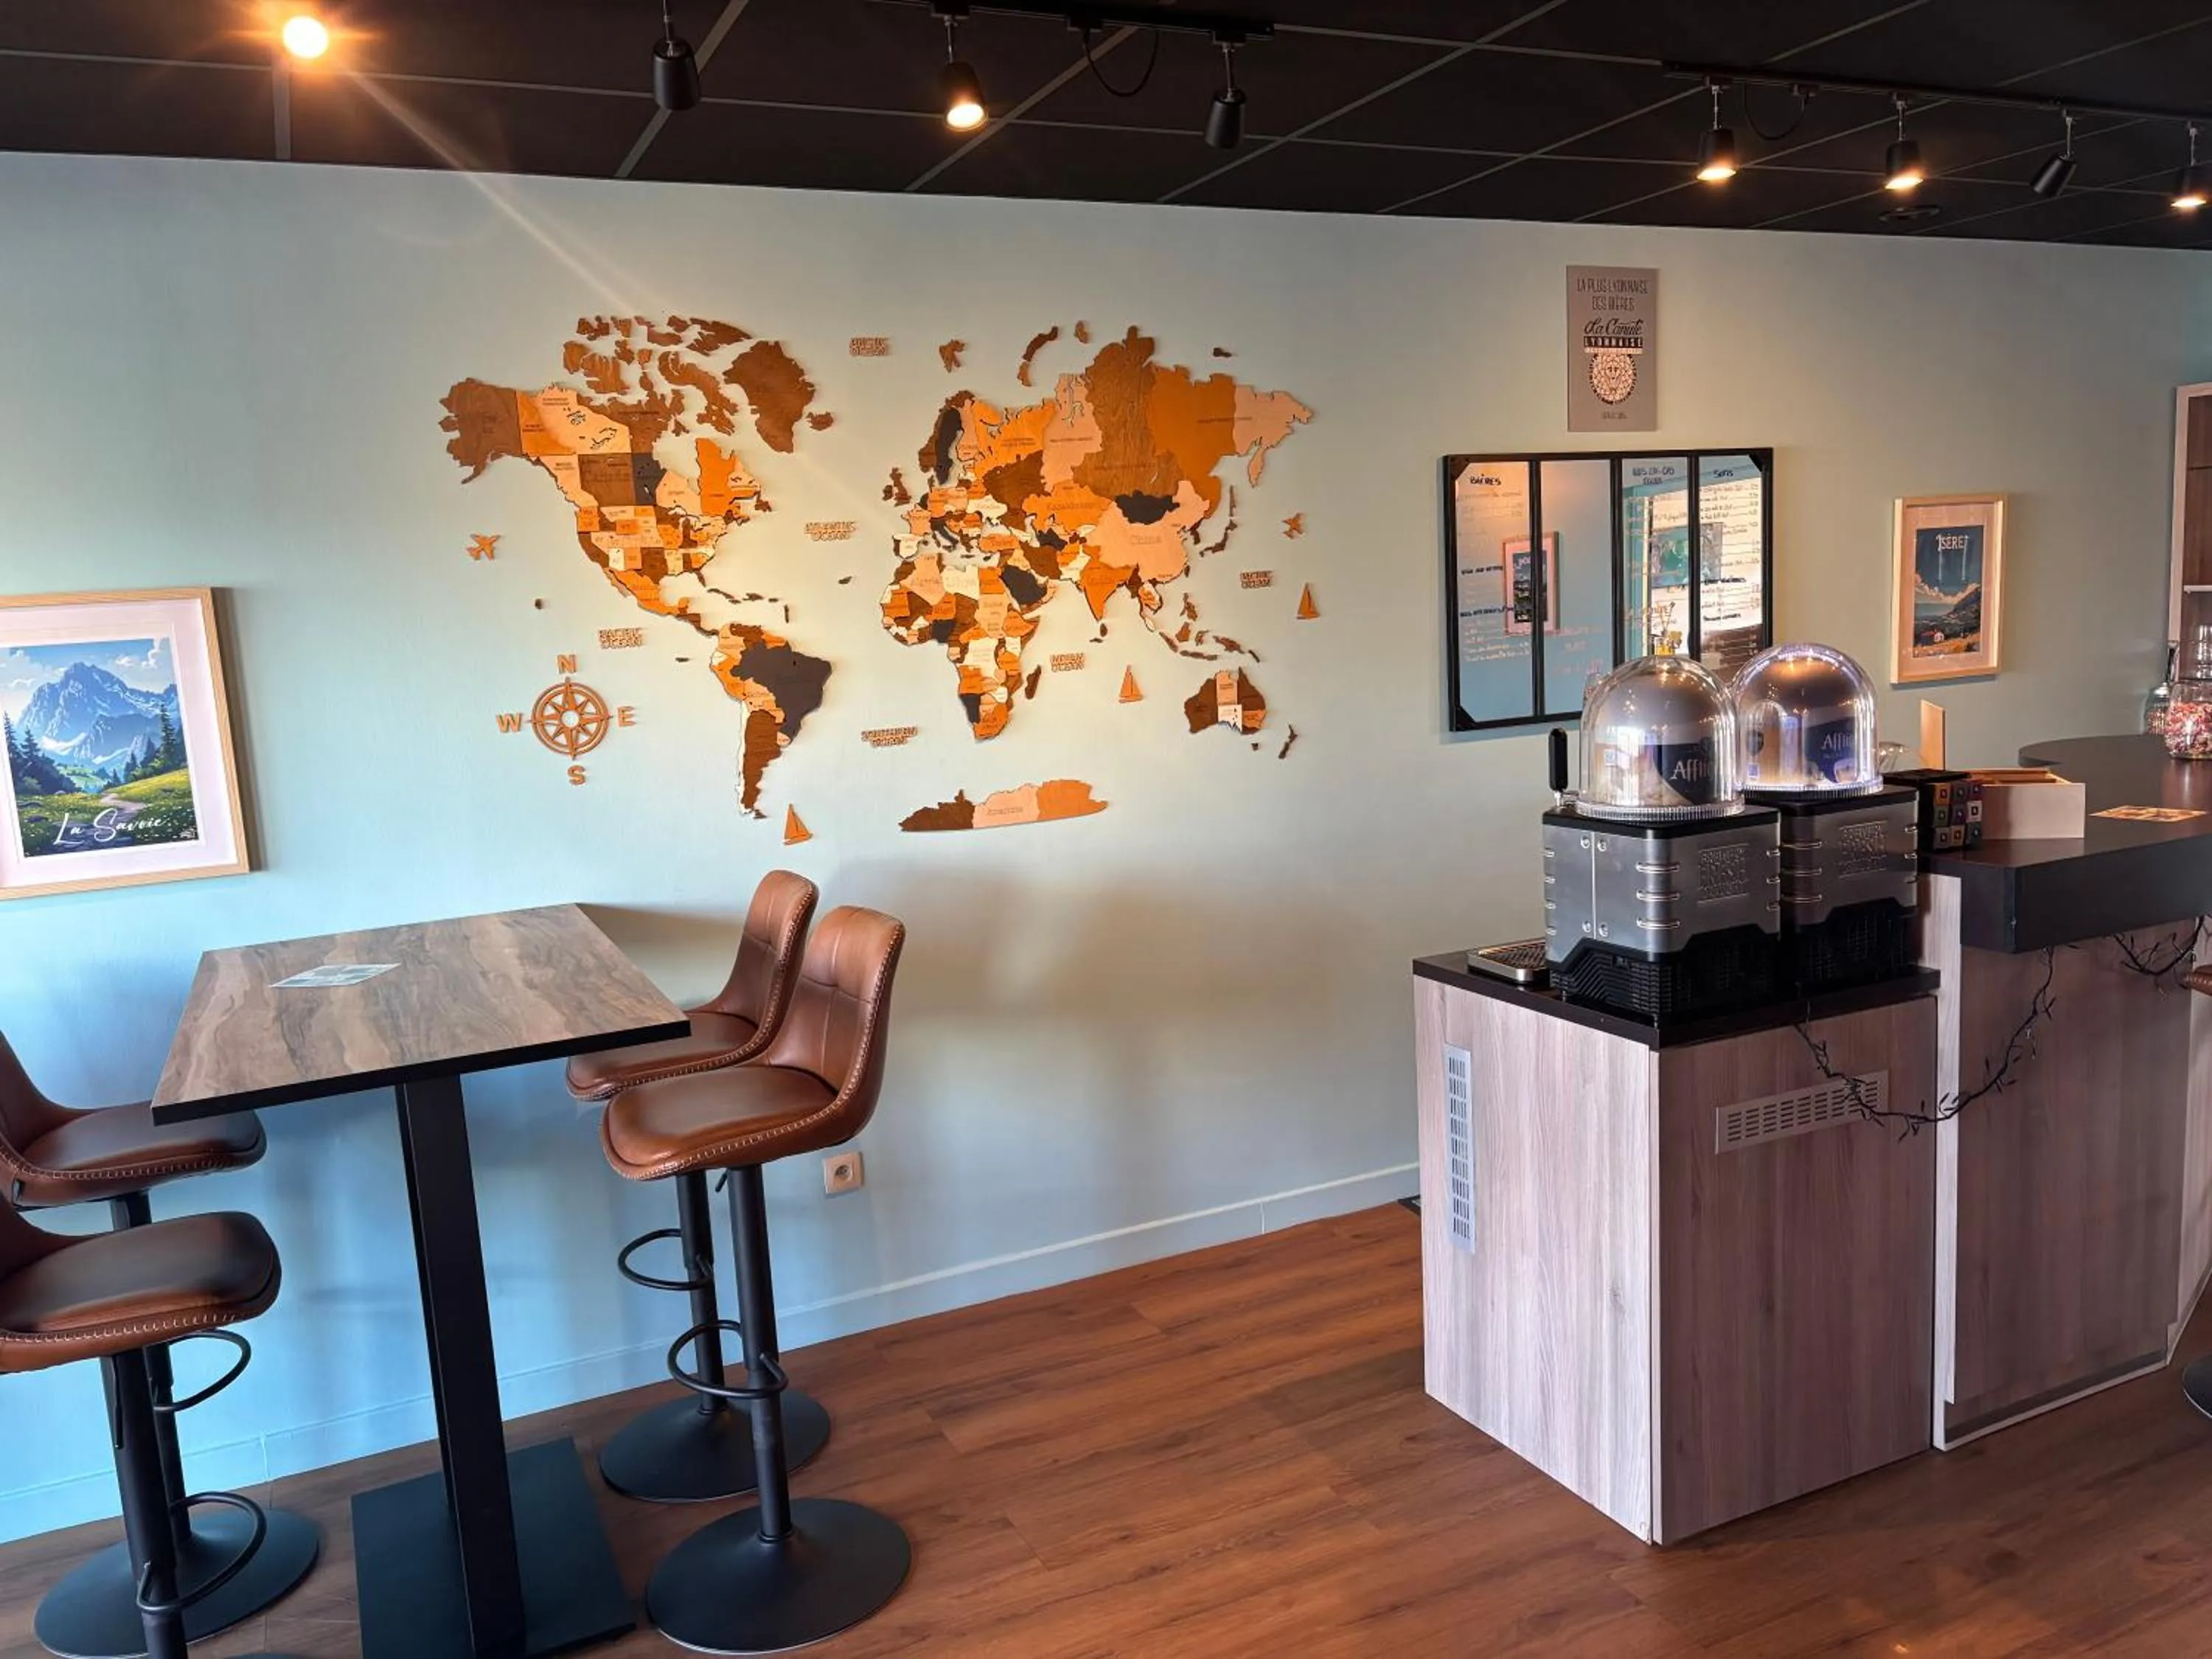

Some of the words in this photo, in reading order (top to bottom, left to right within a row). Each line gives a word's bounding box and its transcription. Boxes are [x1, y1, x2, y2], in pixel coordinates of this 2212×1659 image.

[1587, 278, 1606, 293] PLUS
[1607, 279, 1648, 294] LYONNAISE
[1592, 296, 1607, 311] DES
[1585, 336, 1643, 347] LYONNAISE
[557, 655, 577, 674] N
[496, 712, 522, 734] W
[617, 706, 636, 727] E
[567, 765, 587, 786] S
[53, 811, 85, 846] La
[93, 808, 170, 844] Savoie
